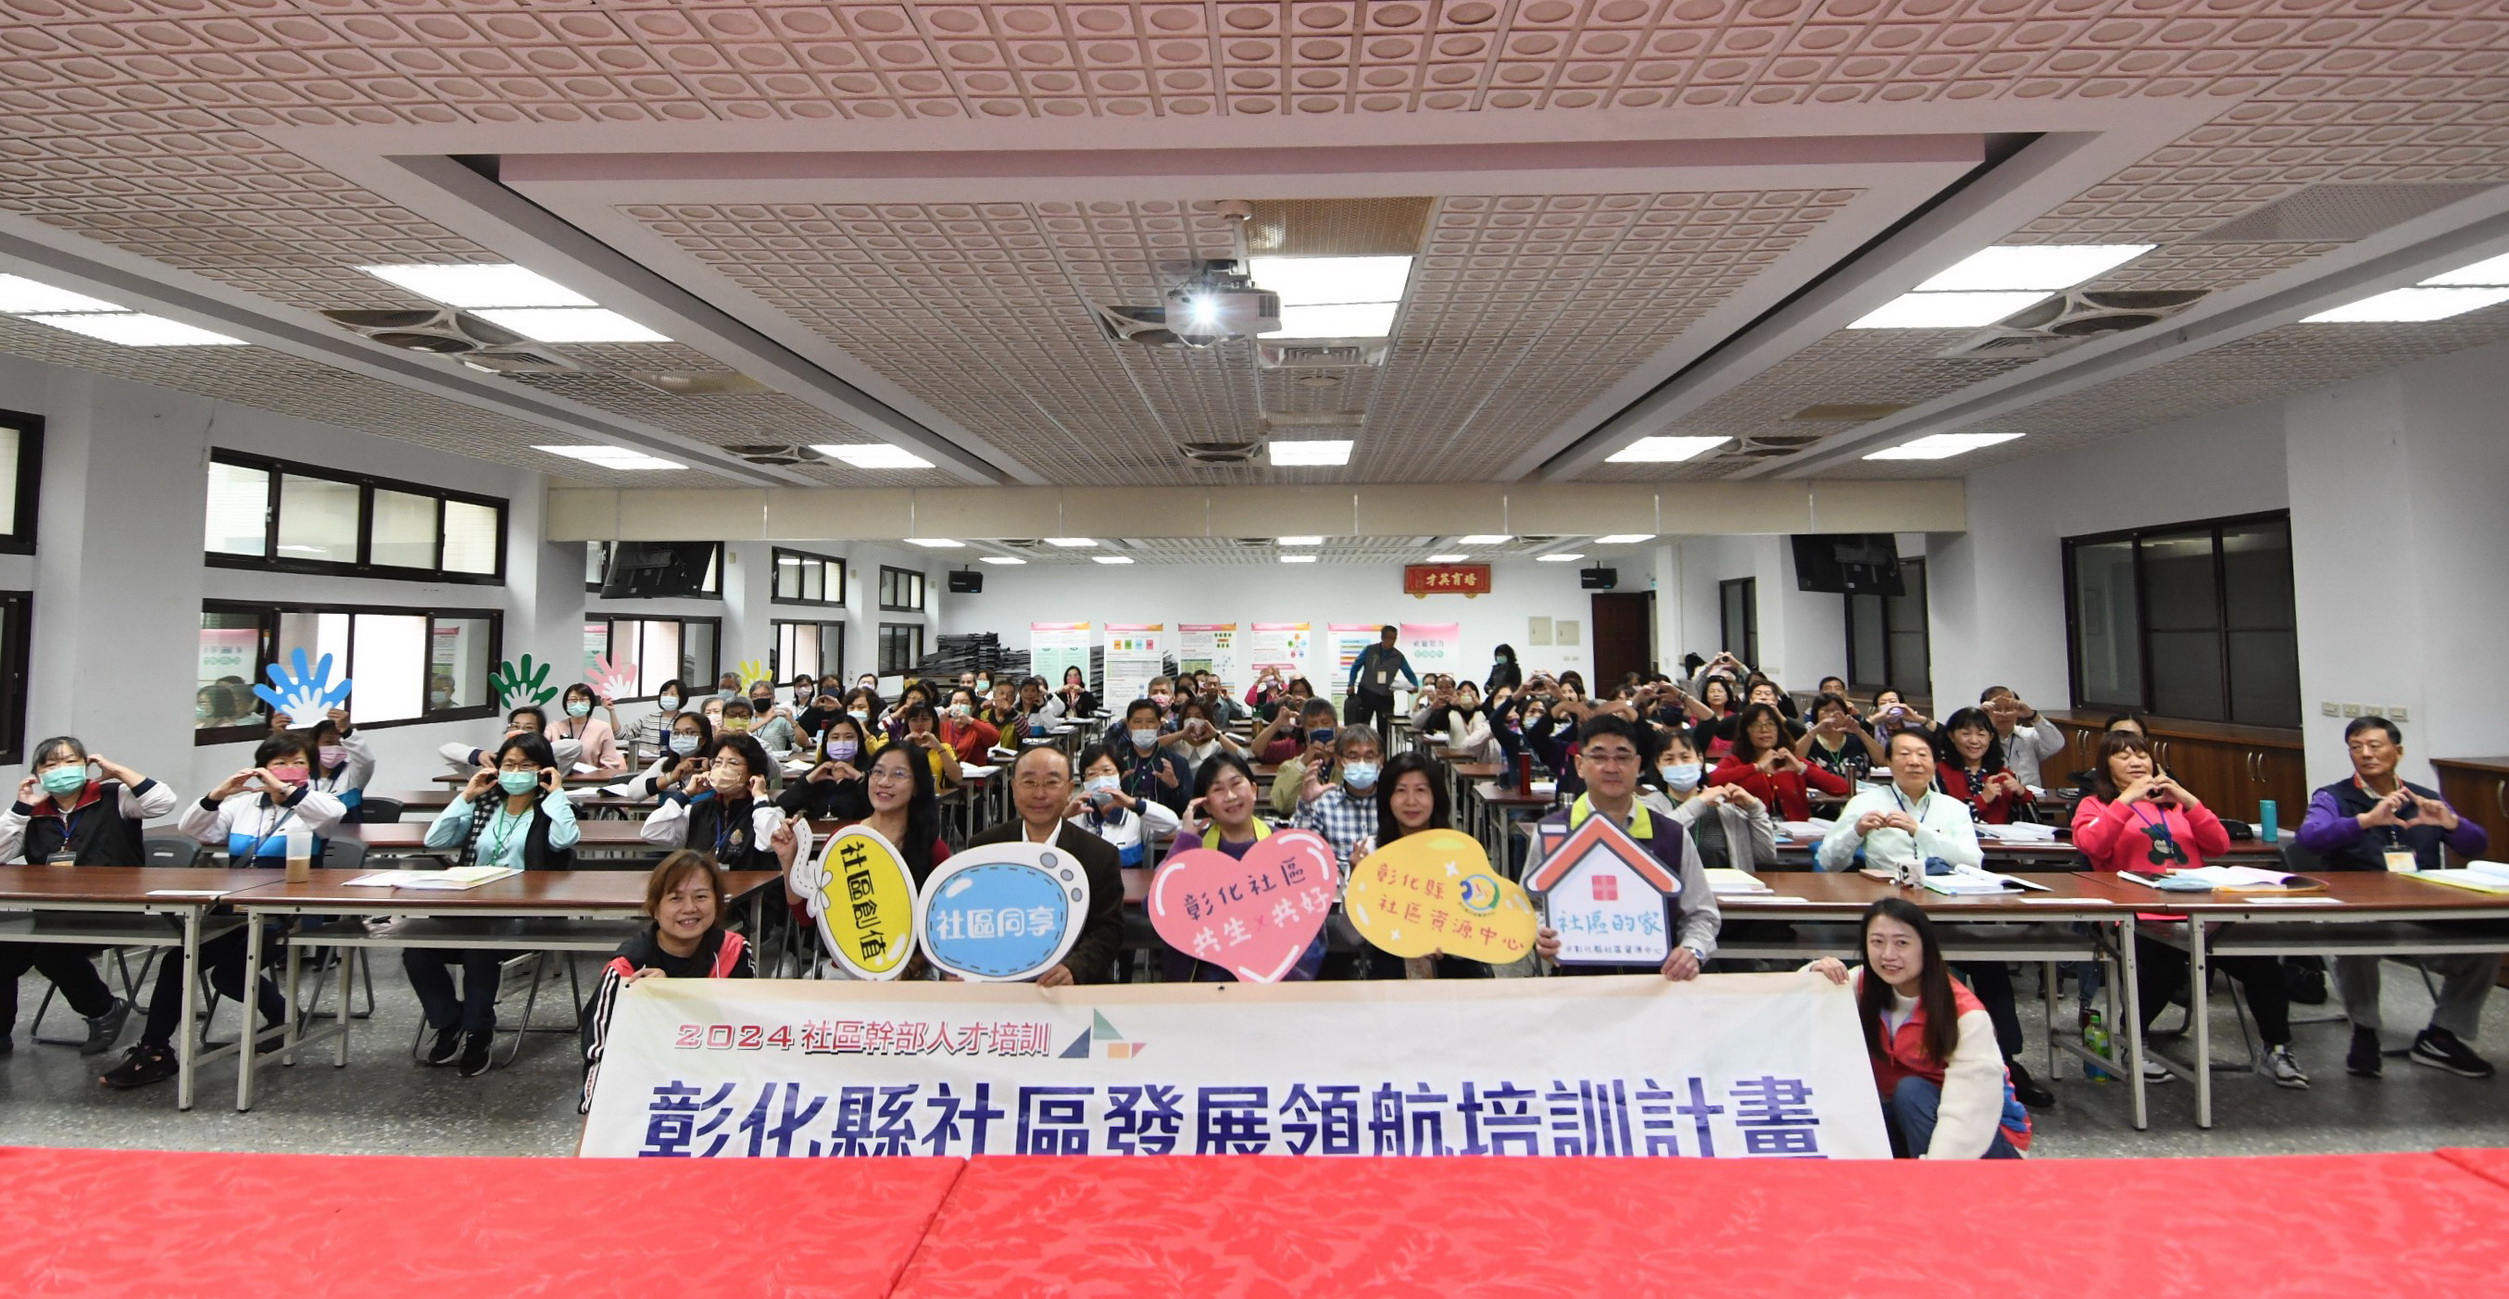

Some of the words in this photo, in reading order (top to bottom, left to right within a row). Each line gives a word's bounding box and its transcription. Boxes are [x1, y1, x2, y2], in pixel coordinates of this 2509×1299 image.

[840, 841, 886, 961] 社區創值
[1184, 857, 1306, 921] 彰化社區
[1377, 863, 1446, 900] 彰化縣
[936, 905, 1056, 940] 社區同享
[1379, 895, 1524, 951] 社區資源中心
[1558, 910, 1662, 936] 社區的家
[675, 1024, 794, 1050] 2024
[801, 1019, 1053, 1055] 社區幹部人才培訓
[639, 1077, 1827, 1158] 彰化縣社區發展領航培訓計畫
